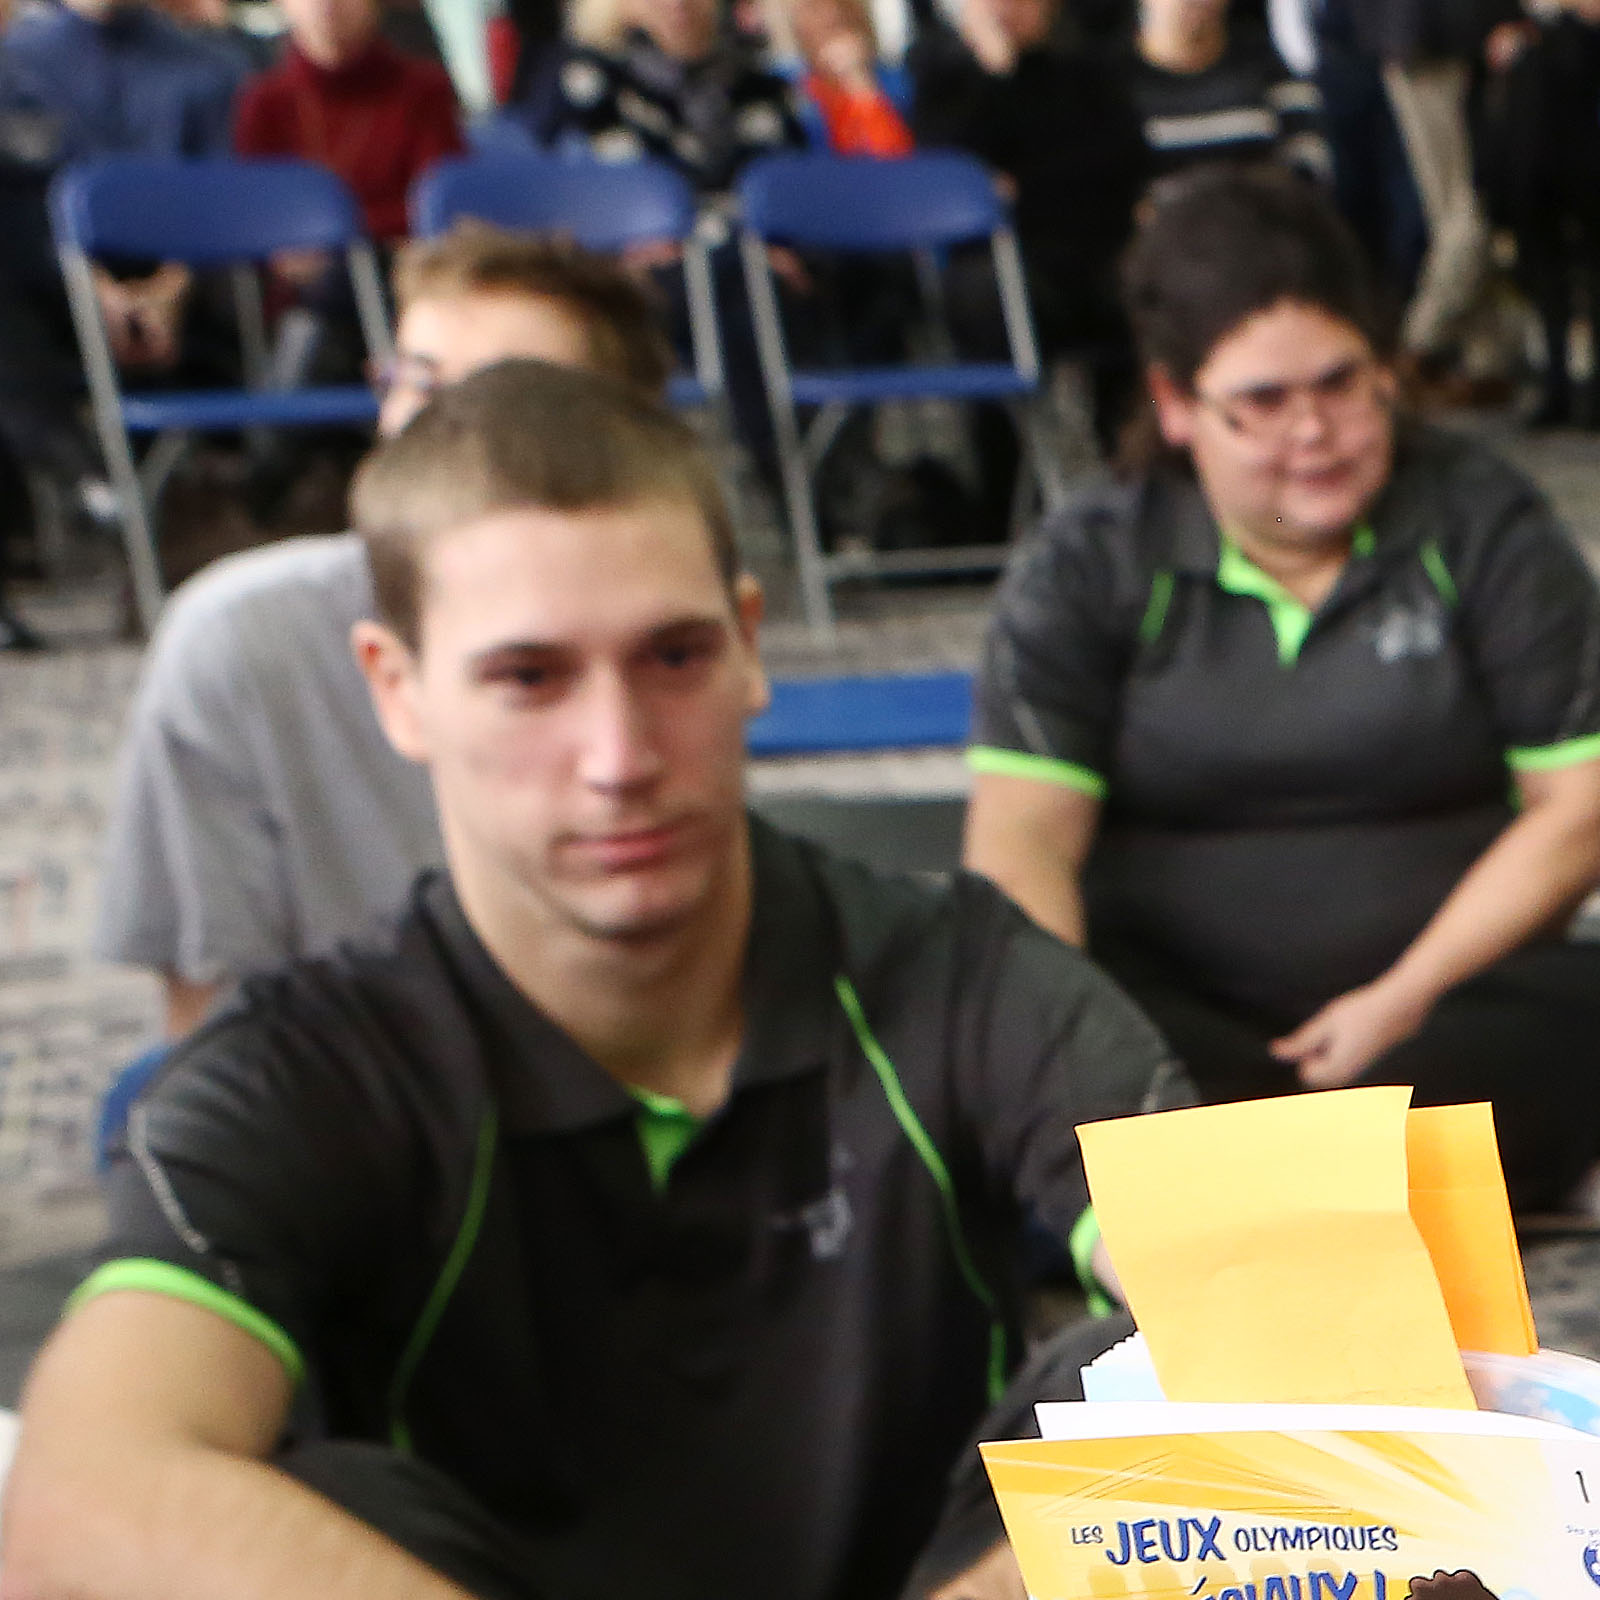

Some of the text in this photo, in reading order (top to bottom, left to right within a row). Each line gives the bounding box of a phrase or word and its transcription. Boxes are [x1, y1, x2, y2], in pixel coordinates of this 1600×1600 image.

[1575, 1470, 1590, 1504] 1
[1072, 1516, 1399, 1565] LES JEUX OLYMPIQUES
